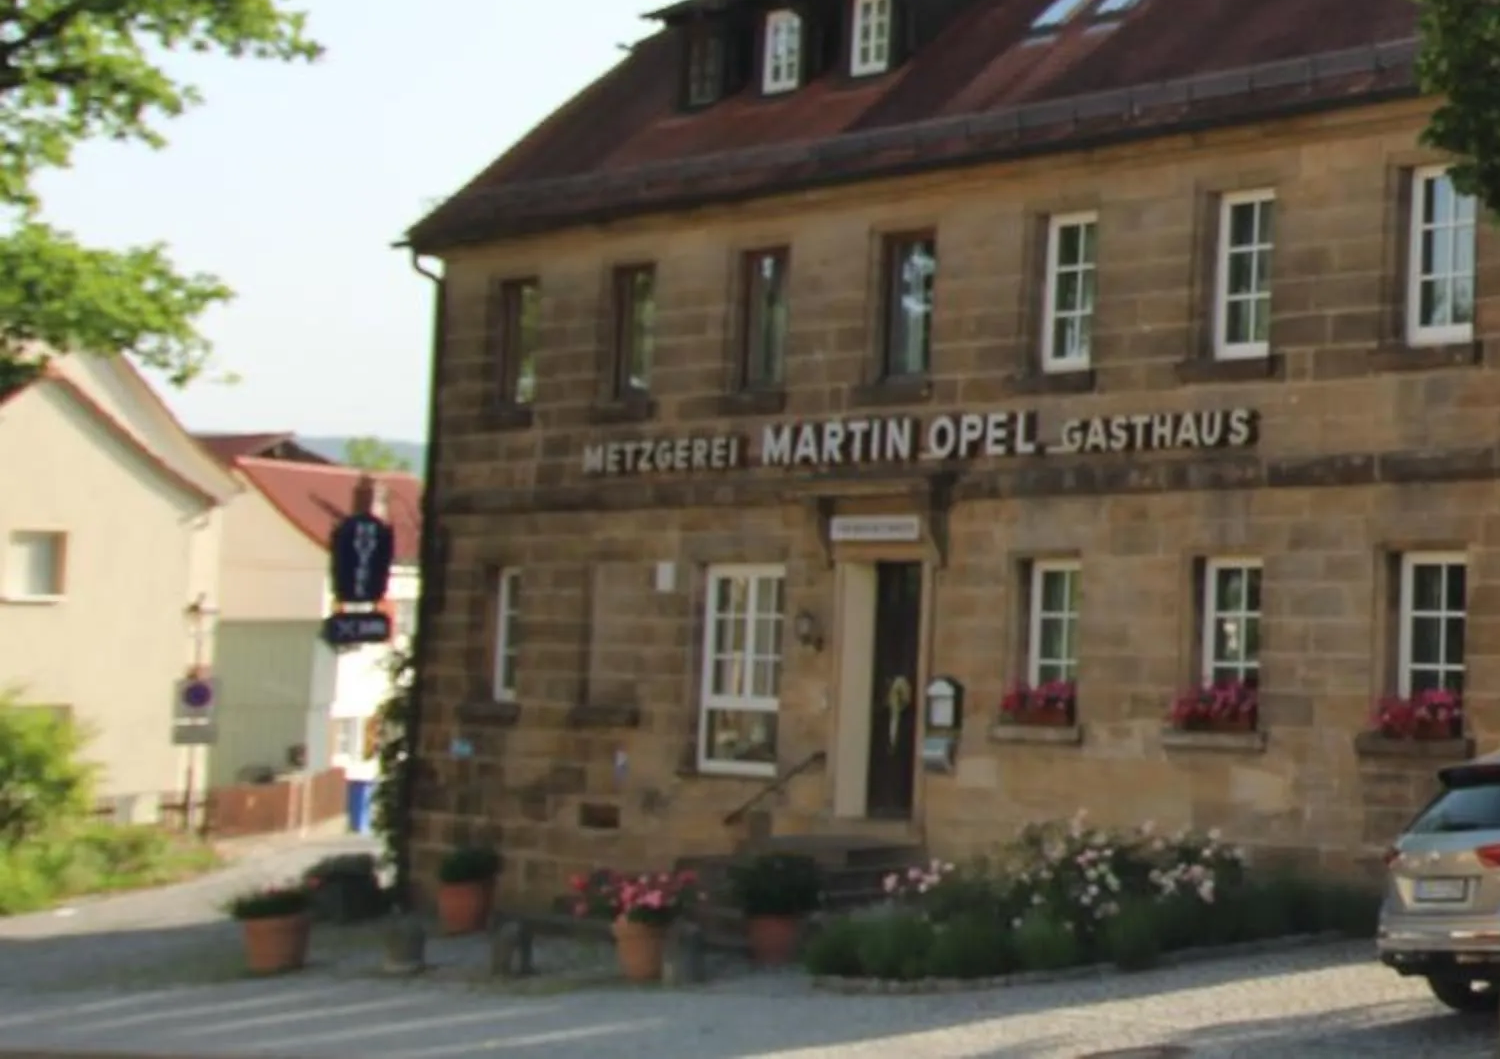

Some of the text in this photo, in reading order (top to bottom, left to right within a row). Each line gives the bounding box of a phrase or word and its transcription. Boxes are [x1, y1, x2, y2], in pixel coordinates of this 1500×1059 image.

[583, 407, 1250, 473] METZGEREI MARTIN OPEL GASTHAUS
